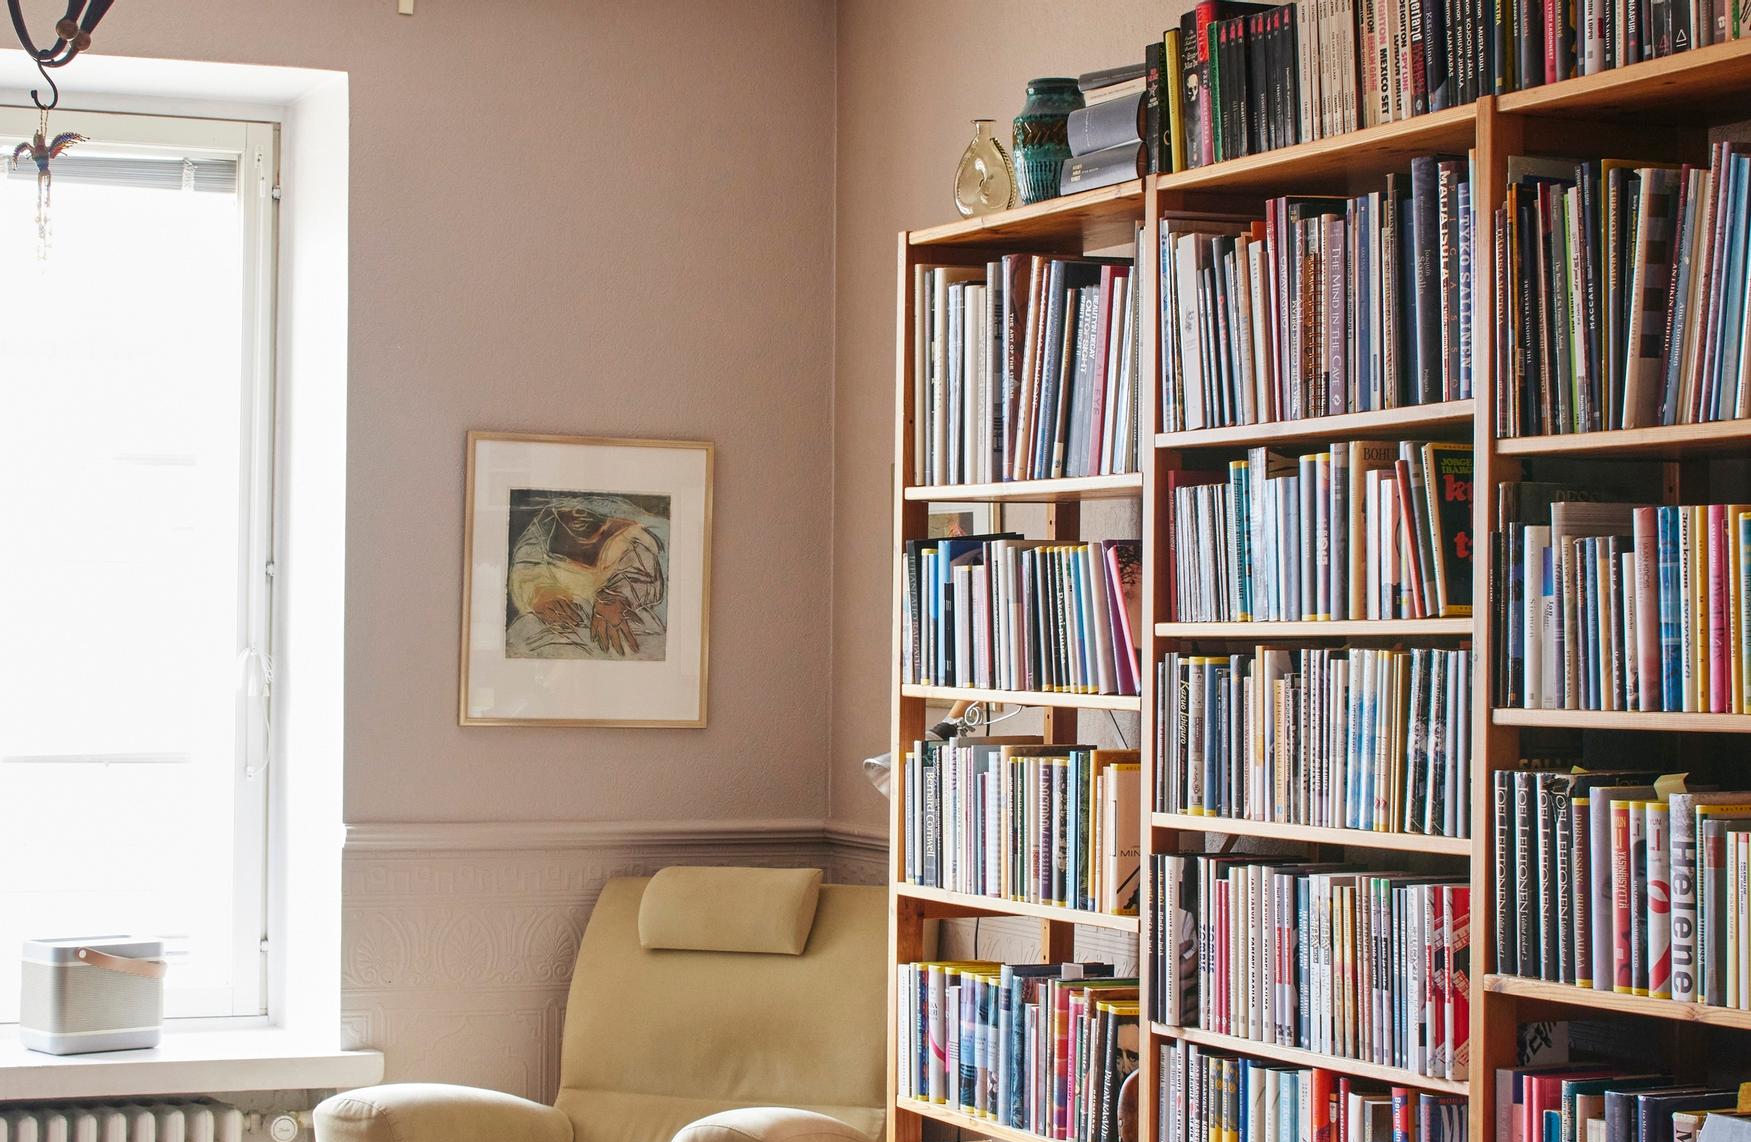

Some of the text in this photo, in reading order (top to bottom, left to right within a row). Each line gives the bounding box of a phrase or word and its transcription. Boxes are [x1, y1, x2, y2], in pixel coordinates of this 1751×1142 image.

[1380, 48, 1389, 114] MEXICO SET
[1460, 215, 1472, 368] TYKO SALLINEN
[1089, 334, 1097, 360] DECAY
[1179, 680, 1190, 745] Kazuo Ishiguro
[926, 771, 936, 858] Bernard Cornwell
[1497, 825, 1508, 913] LEHTONEN
[1518, 825, 1530, 914] LEHTONEN
[1541, 828, 1550, 917] LEHTONEN
[1559, 830, 1569, 920] LEHTONEN
[1671, 840, 1695, 994] Helene
